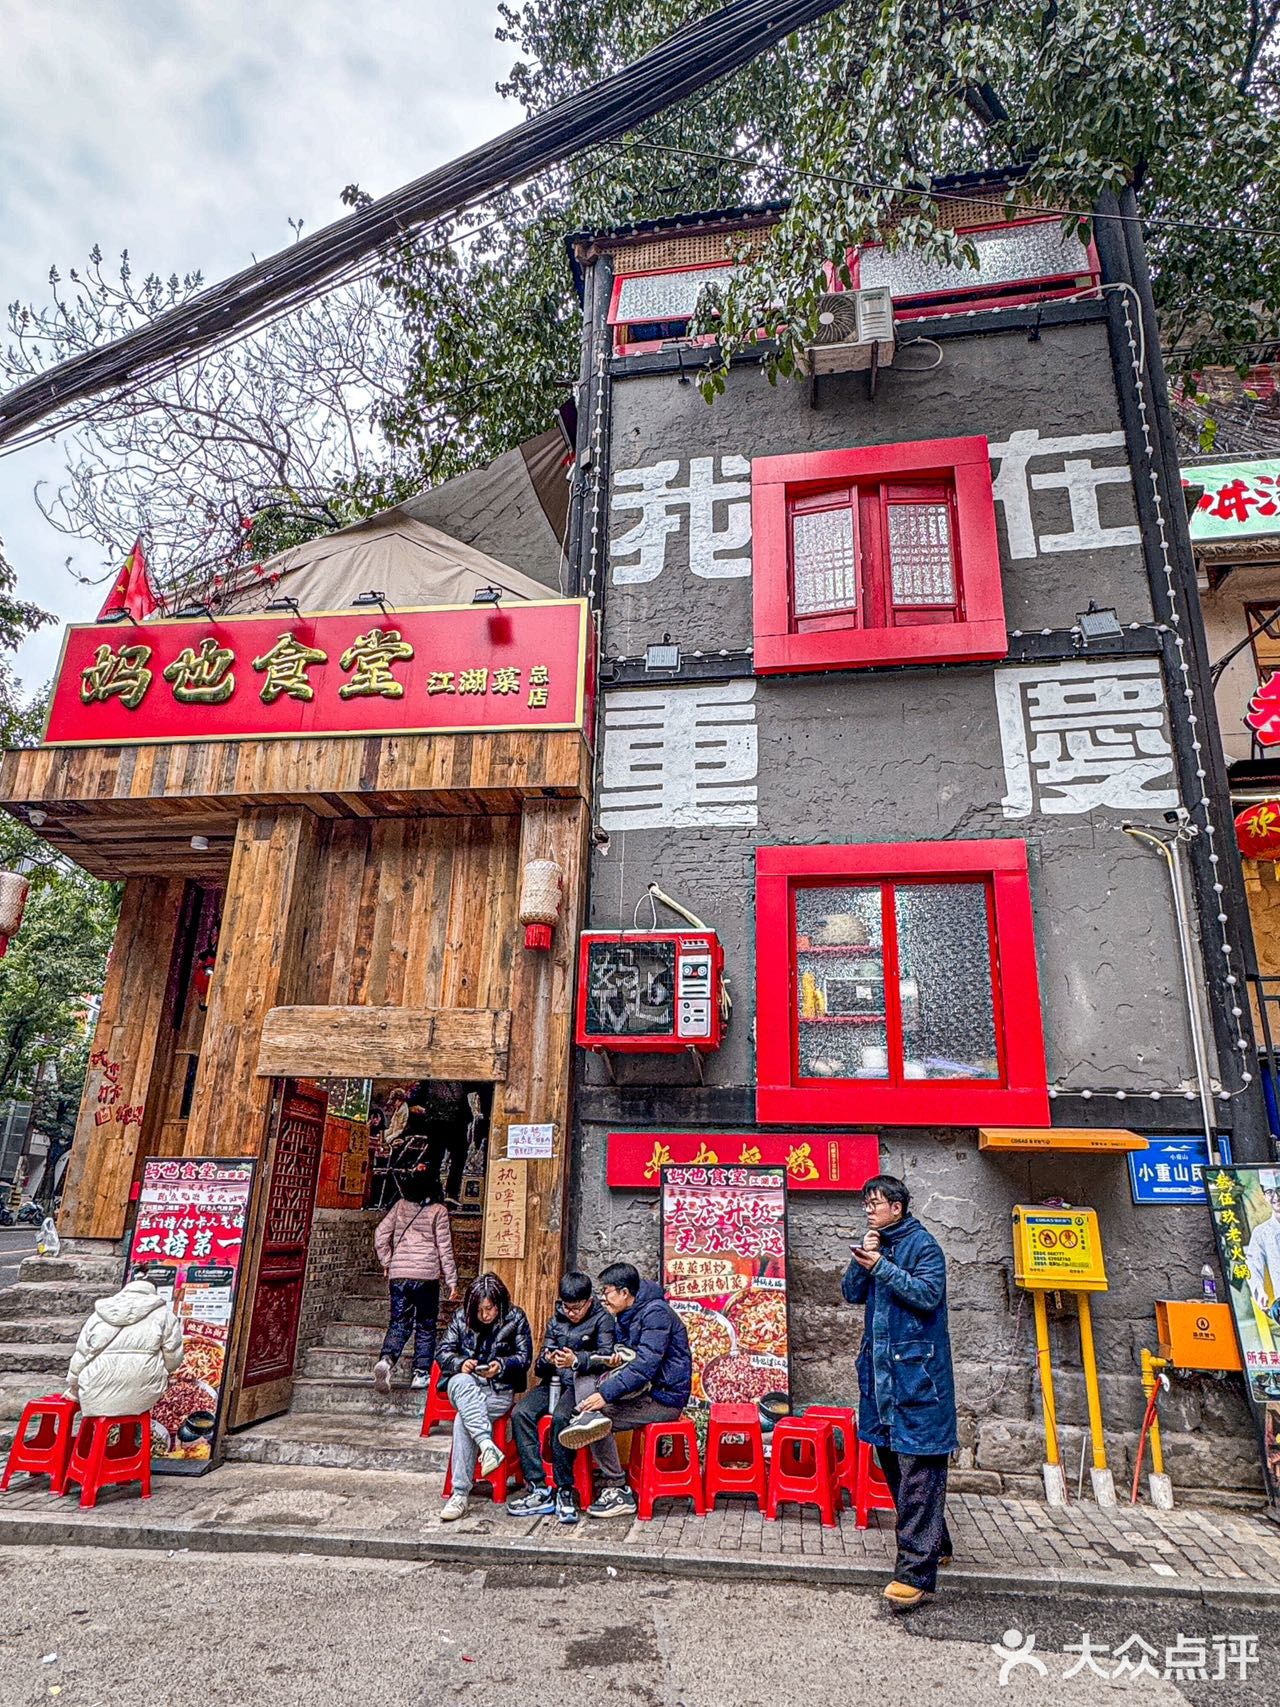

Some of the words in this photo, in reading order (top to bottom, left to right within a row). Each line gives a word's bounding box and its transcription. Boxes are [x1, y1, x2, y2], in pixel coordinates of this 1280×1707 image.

[987, 429, 1143, 560] 在
[426, 666, 523, 695] 江湖菜
[527, 664, 549, 709] 总店
[599, 679, 759, 831] 重
[144, 1161, 217, 1180] 妈也食堂
[666, 1167, 748, 1185] 妈也食堂
[664, 1198, 779, 1227] 老店升级
[1214, 1171, 1252, 1280] 叁伍玖老火锅
[136, 1228, 242, 1258] 双榜第一
